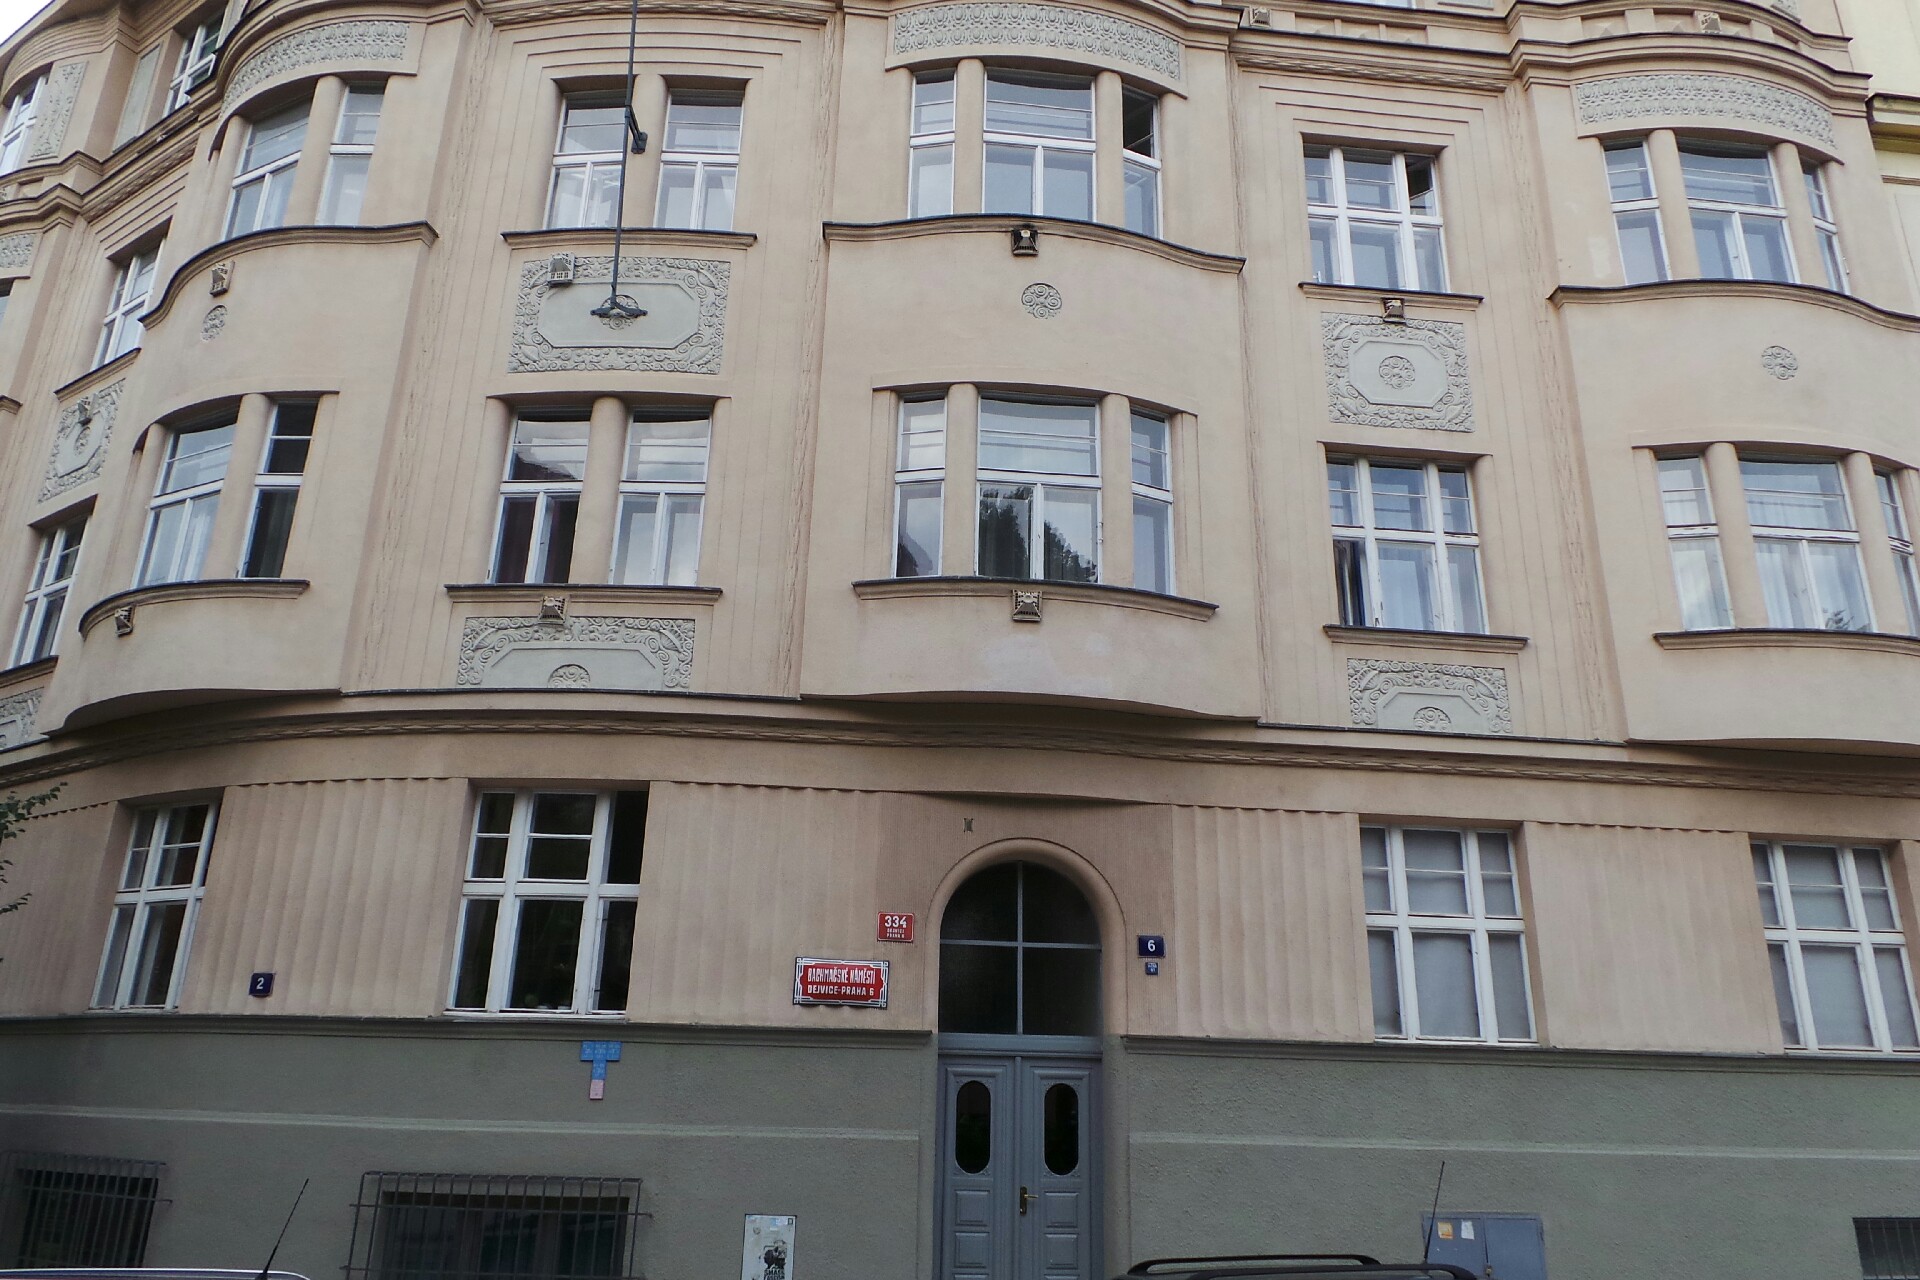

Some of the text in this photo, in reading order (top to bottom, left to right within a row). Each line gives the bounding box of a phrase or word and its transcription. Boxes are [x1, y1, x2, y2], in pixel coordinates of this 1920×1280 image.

[884, 915, 907, 928] 334
[1147, 939, 1156, 952] 6
[849, 967, 876, 985] NÁMĚSTÍ
[256, 977, 265, 990] 2
[869, 987, 875, 996] 6
